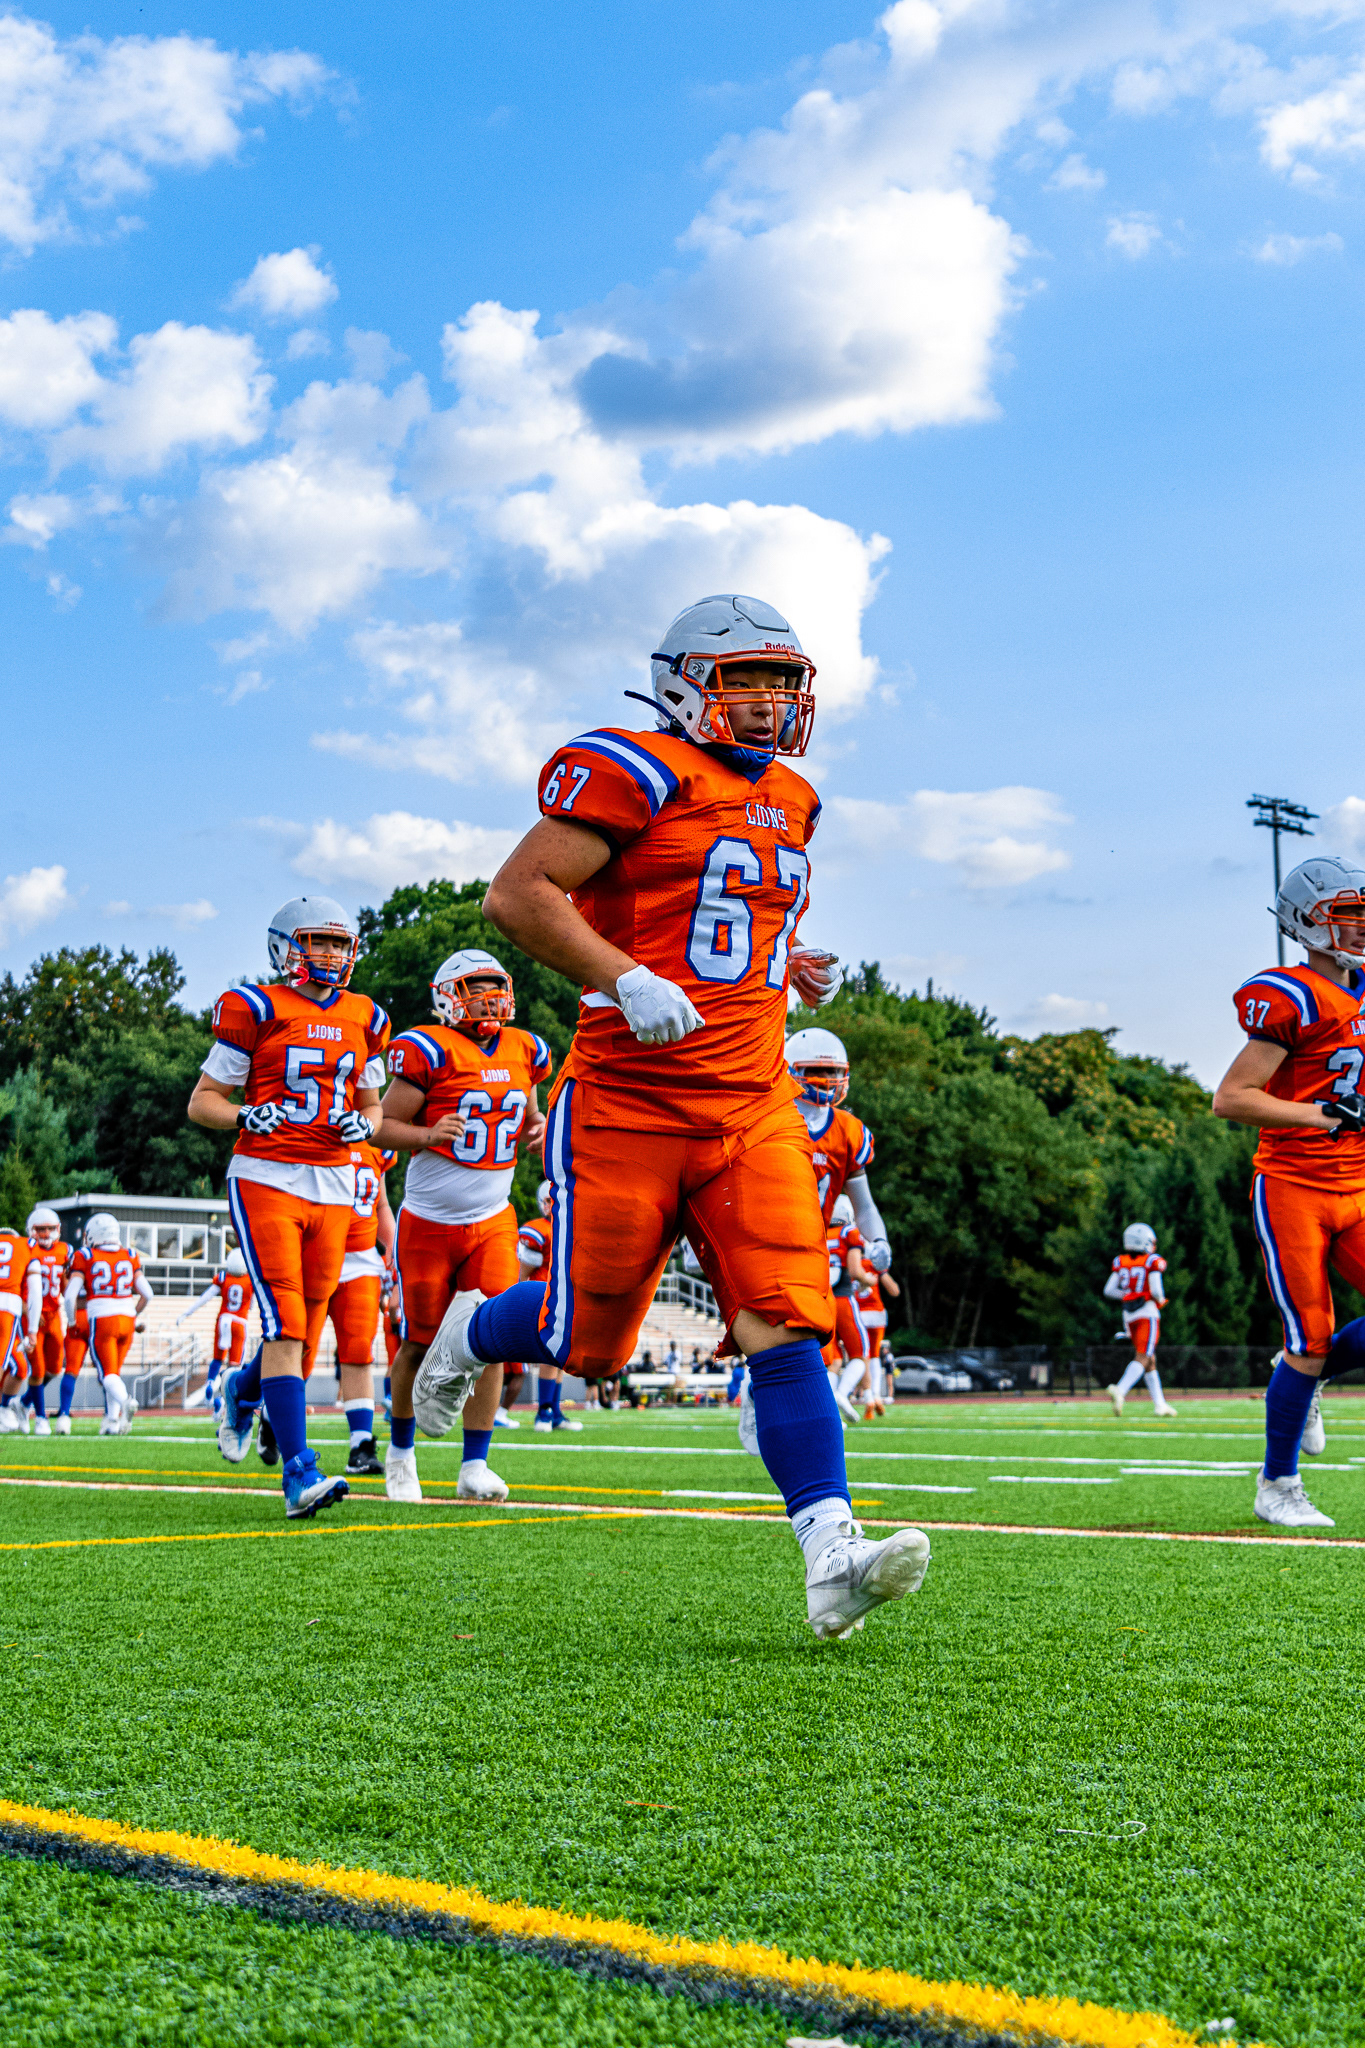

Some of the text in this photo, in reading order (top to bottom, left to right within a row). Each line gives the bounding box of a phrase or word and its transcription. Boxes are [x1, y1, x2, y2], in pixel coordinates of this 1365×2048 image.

[765, 642, 796, 652] Riddell
[542, 762, 592, 812] 67
[746, 802, 789, 831] LIONS
[684, 835, 809, 992] 67
[1244, 997, 1271, 1029] 37
[307, 1024, 343, 1042] LIONS
[387, 1049, 405, 1075] 62
[480, 1069, 511, 1083] LIONS
[282, 1045, 356, 1126] 51
[451, 1089, 528, 1164] 62
[90, 1260, 135, 1297] 22
[227, 1283, 244, 1313] 9
